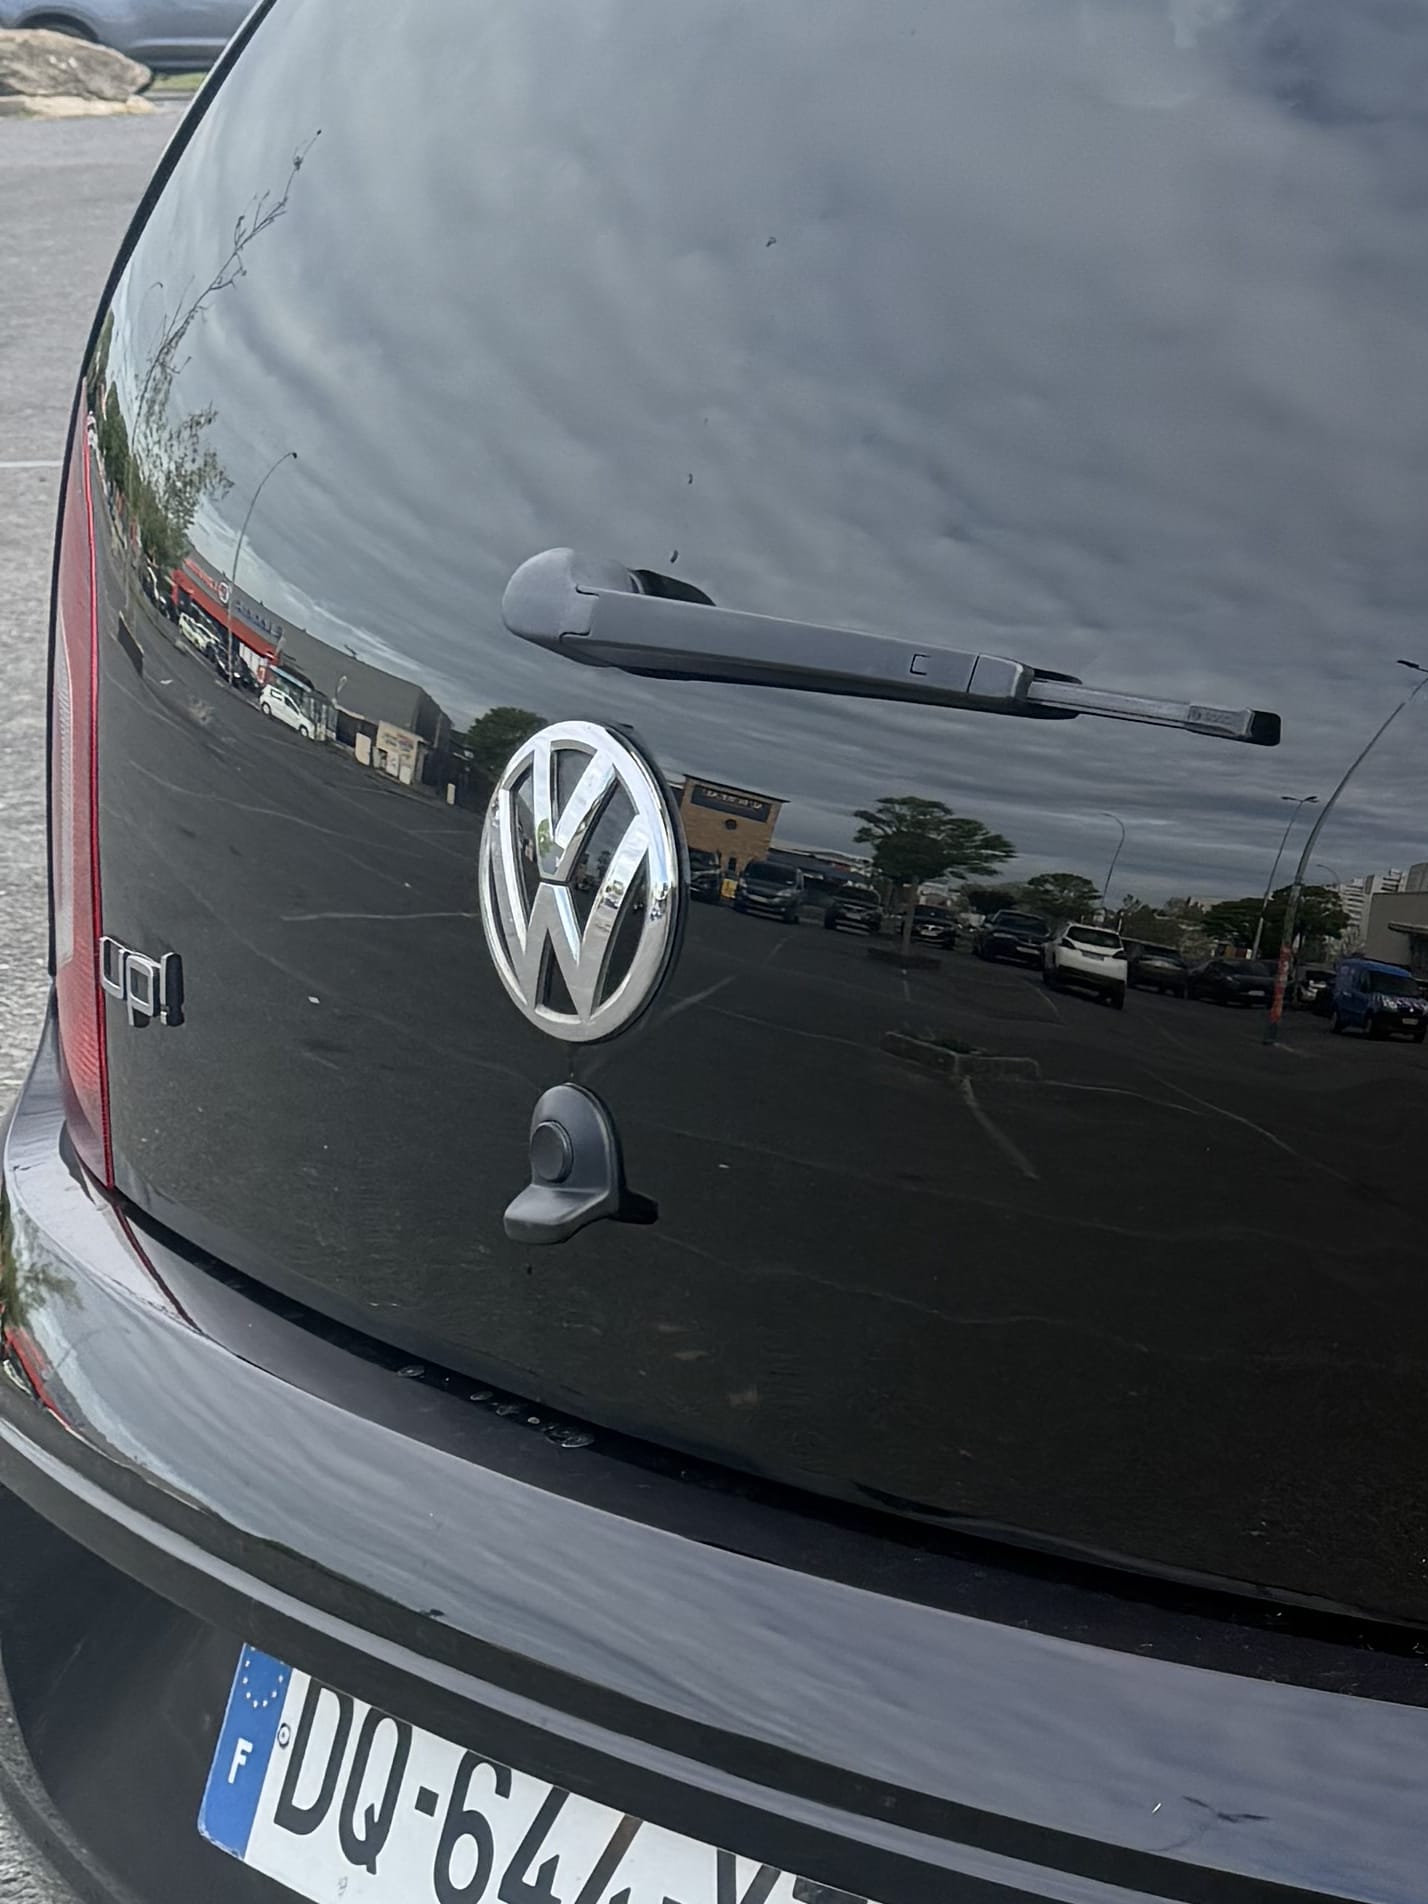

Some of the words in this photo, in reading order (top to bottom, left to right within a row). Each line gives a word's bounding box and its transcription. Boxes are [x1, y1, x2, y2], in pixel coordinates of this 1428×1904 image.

[480, 720, 680, 1042] VW
[99, 935, 185, 1028] up!
[227, 1737, 253, 1785] F
